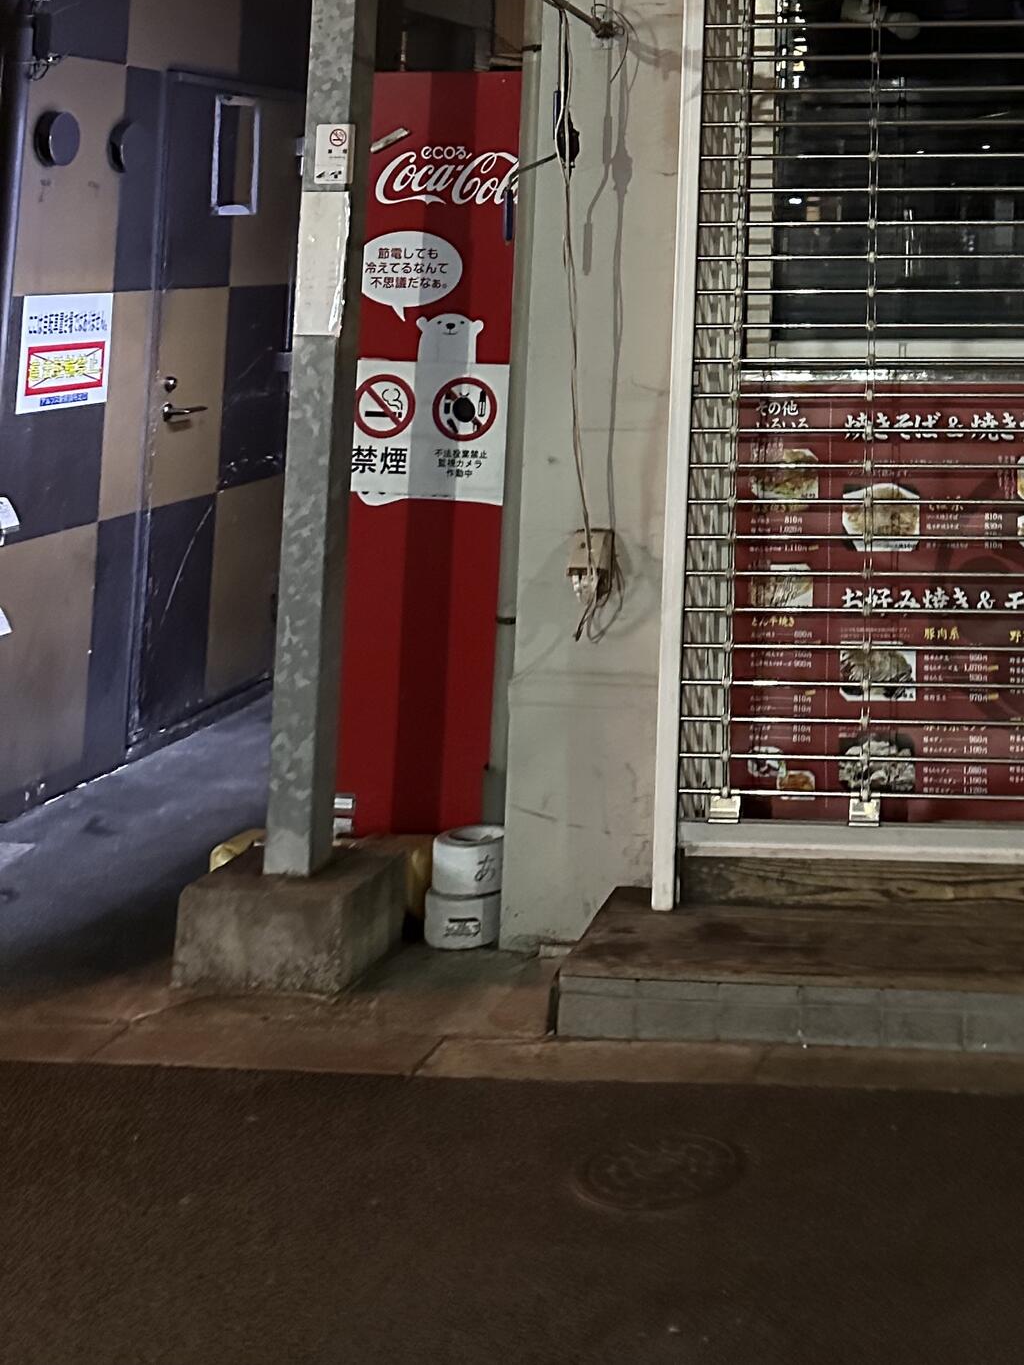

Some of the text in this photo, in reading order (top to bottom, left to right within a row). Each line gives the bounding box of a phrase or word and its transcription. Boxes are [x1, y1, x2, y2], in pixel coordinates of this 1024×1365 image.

[377, 247, 438, 260] 節電しても
[365, 262, 449, 274] 冷えてるなんて
[755, 401, 799, 416] その他
[844, 412, 942, 441] 焼きそば
[351, 445, 408, 475] 禁煙
[841, 587, 968, 611] お好み焼き
[923, 626, 959, 640] 豚肉系
